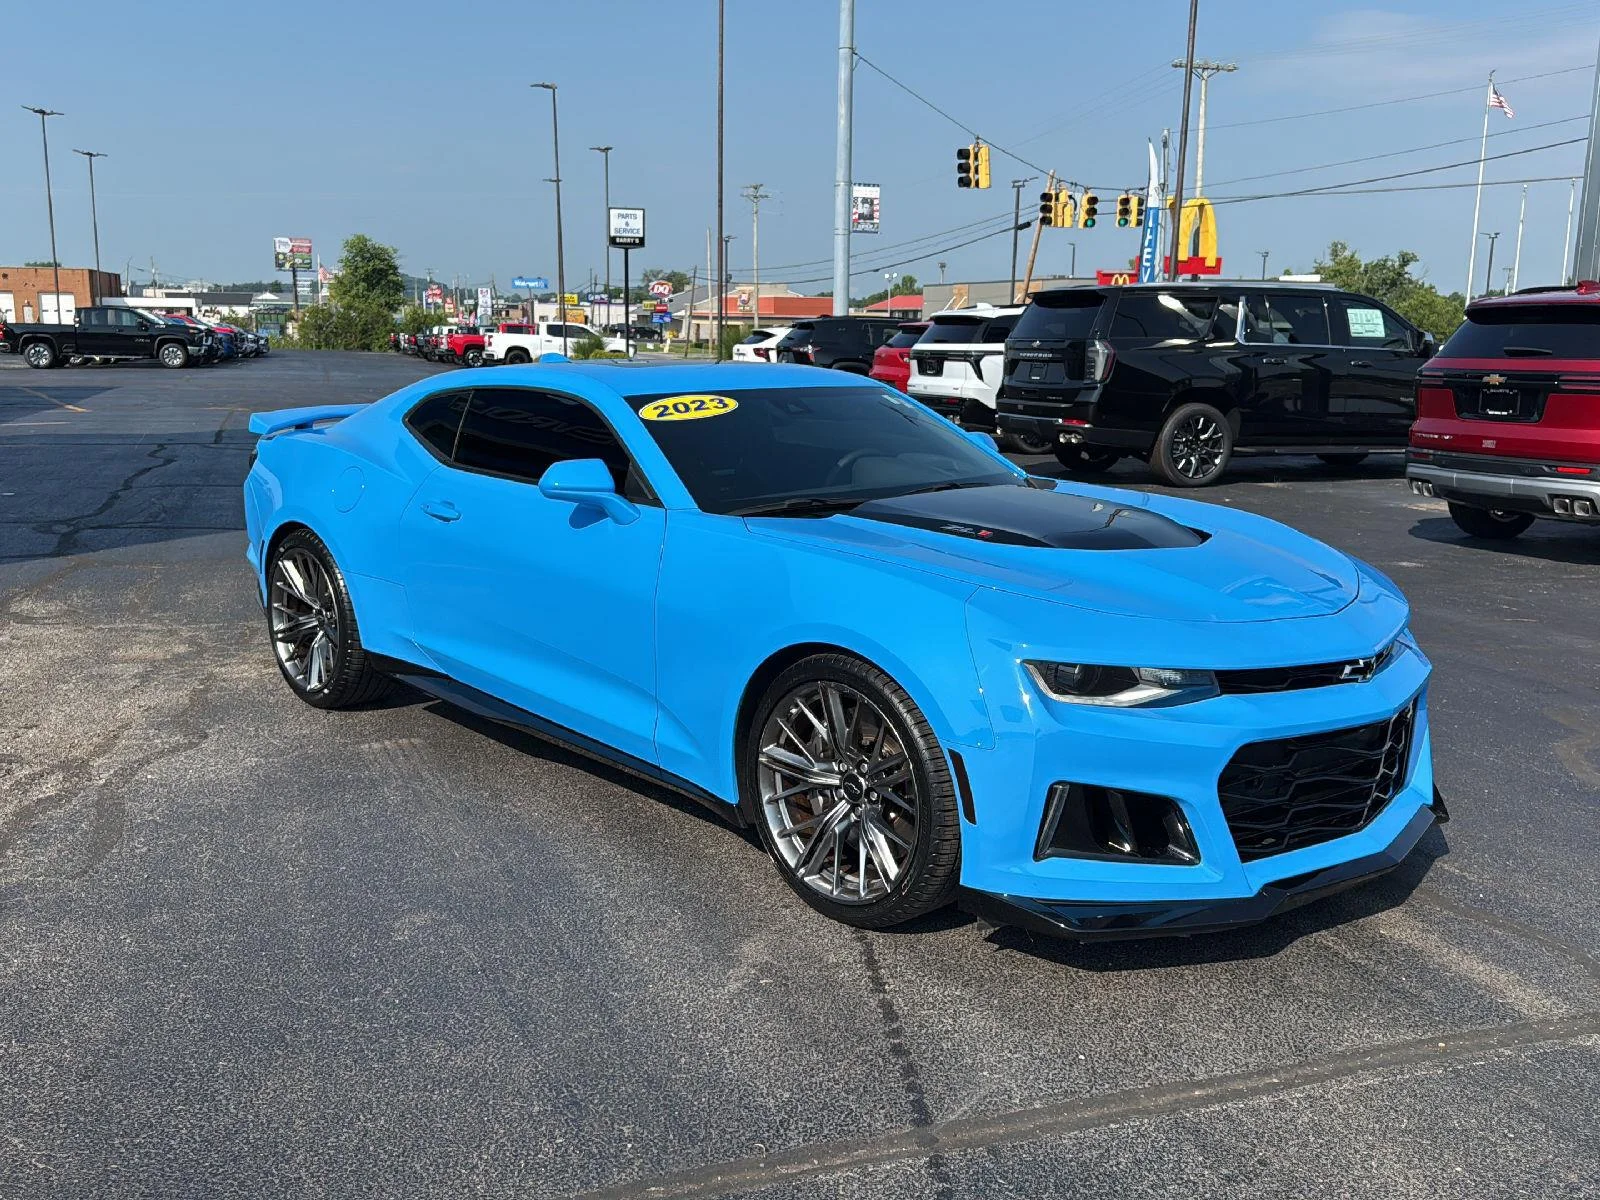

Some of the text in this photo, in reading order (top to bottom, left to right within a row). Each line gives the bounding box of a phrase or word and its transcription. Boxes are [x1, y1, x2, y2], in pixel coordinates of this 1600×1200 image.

[614, 227, 641, 235] SERVICE
[653, 284, 669, 295] DQ
[653, 397, 730, 418] 2023
